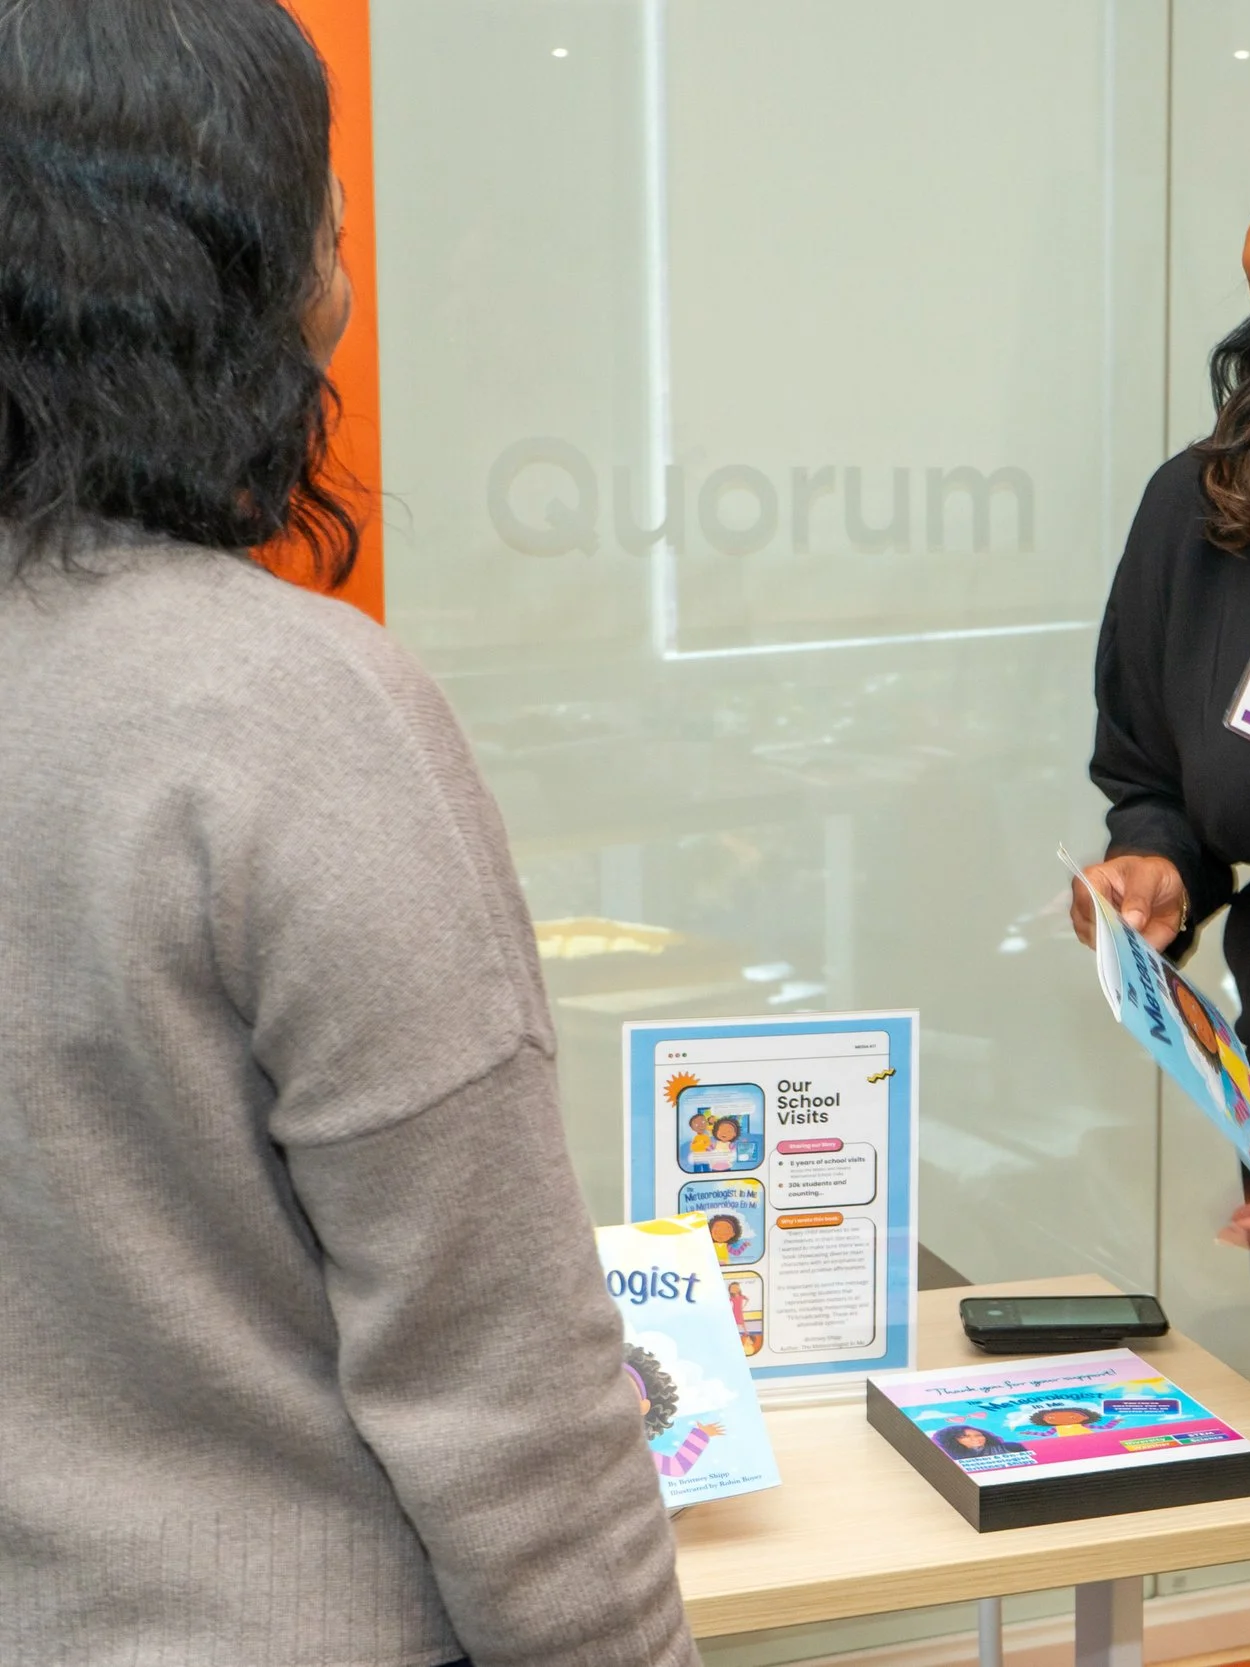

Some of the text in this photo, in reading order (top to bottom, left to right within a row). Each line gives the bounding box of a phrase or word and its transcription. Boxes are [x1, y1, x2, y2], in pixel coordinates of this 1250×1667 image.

[486, 435, 1037, 557] Quorum
[777, 1079, 812, 1094] Our
[777, 1093, 841, 1110] School
[777, 1109, 829, 1126] Visits
[684, 1189, 737, 1202] Meteorologist
[926, 1384, 976, 1396] Thank
[979, 1383, 1001, 1393] you
[978, 1392, 1105, 1412] Meteorologist
[709, 1471, 730, 1480] Shipp
